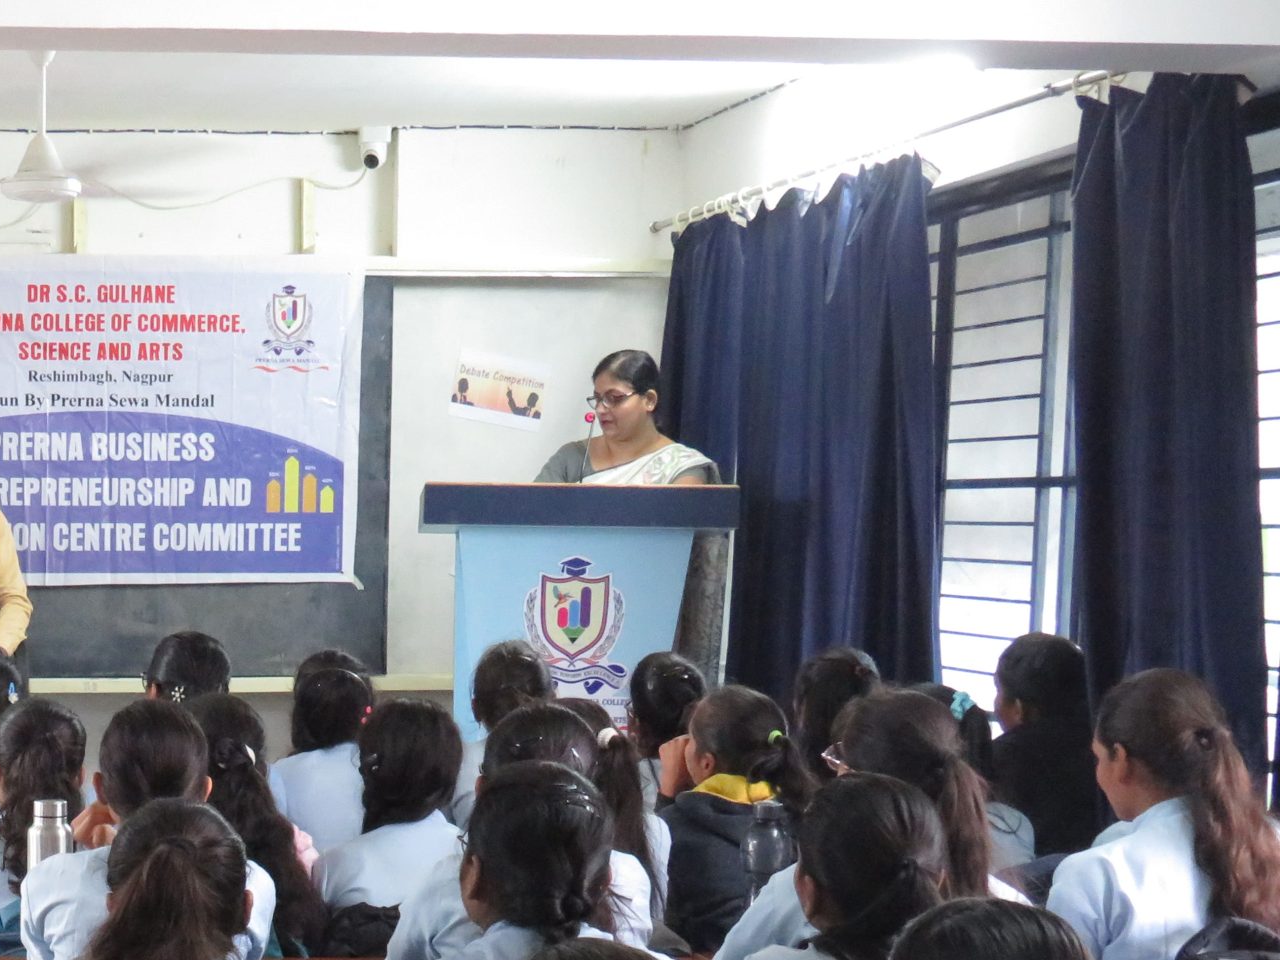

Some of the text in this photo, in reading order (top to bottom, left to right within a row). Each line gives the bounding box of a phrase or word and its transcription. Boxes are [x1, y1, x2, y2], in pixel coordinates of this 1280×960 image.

[27, 284, 176, 303] DR S.C. GULHANE
[30, 313, 105, 332] COLLEGE
[111, 313, 132, 332] OF
[137, 314, 246, 334] COMMERCE,
[18, 342, 183, 361] SCIENCE AND ARTS
[28, 370, 174, 386] Reshimbagh, Nagpur
[460, 364, 544, 390] Debate Competition
[24, 393, 45, 411] By
[50, 393, 104, 408] Prerna
[108, 393, 150, 408] Sewa
[154, 393, 215, 408] Mandal
[91, 432, 216, 462] BUSINESS
[202, 477, 252, 507] AND
[53, 522, 146, 551] CENTRE
[153, 522, 302, 552] COMMITTEE
